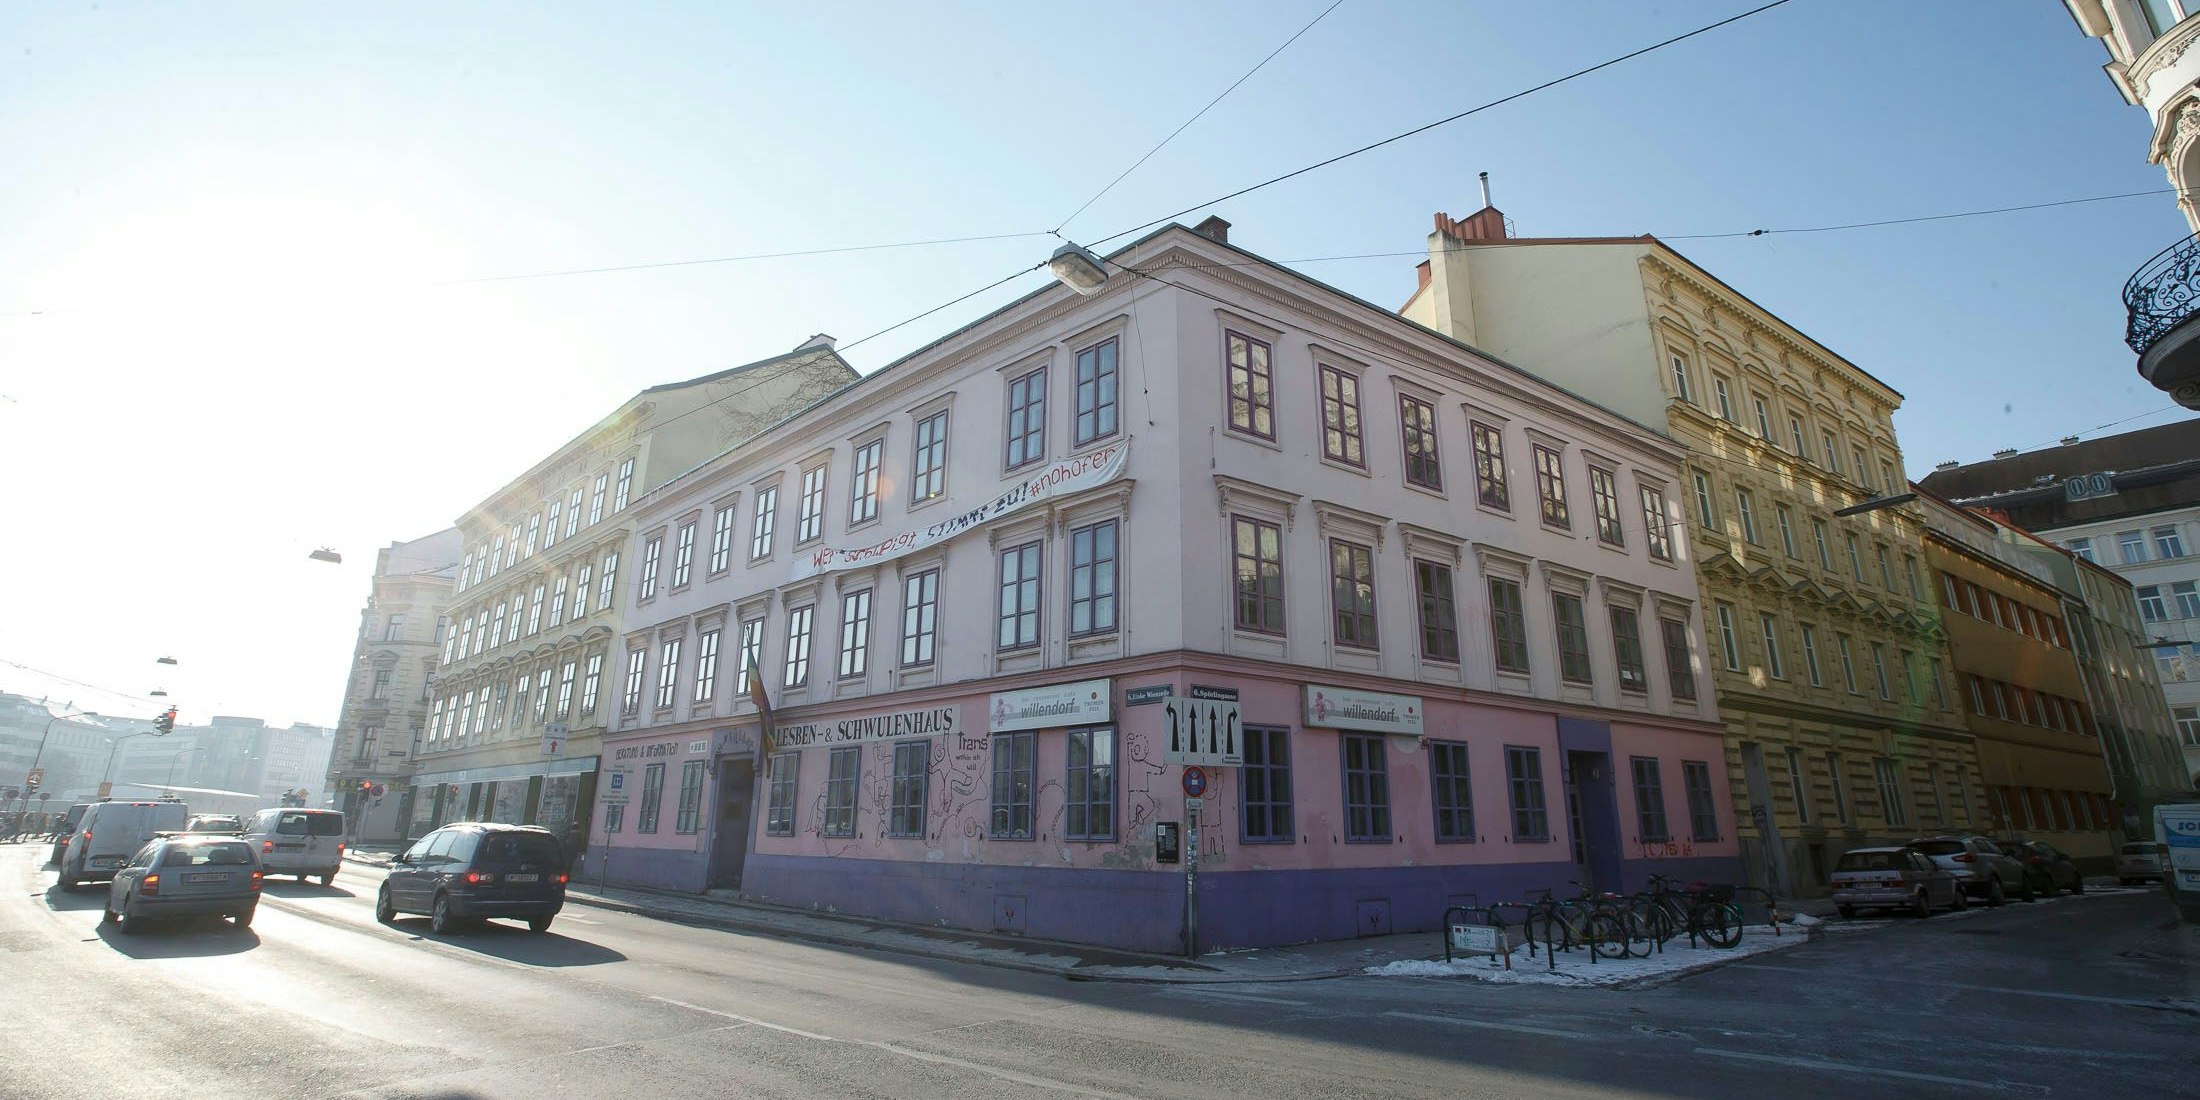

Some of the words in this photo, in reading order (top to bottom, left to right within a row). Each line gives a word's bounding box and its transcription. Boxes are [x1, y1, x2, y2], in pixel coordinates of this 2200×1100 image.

[1021, 698, 1075, 719] willendorf
[1343, 704, 1395, 722] willendorf
[837, 707, 953, 741] SCHWULENHAUS
[958, 731, 988, 751] Trans
